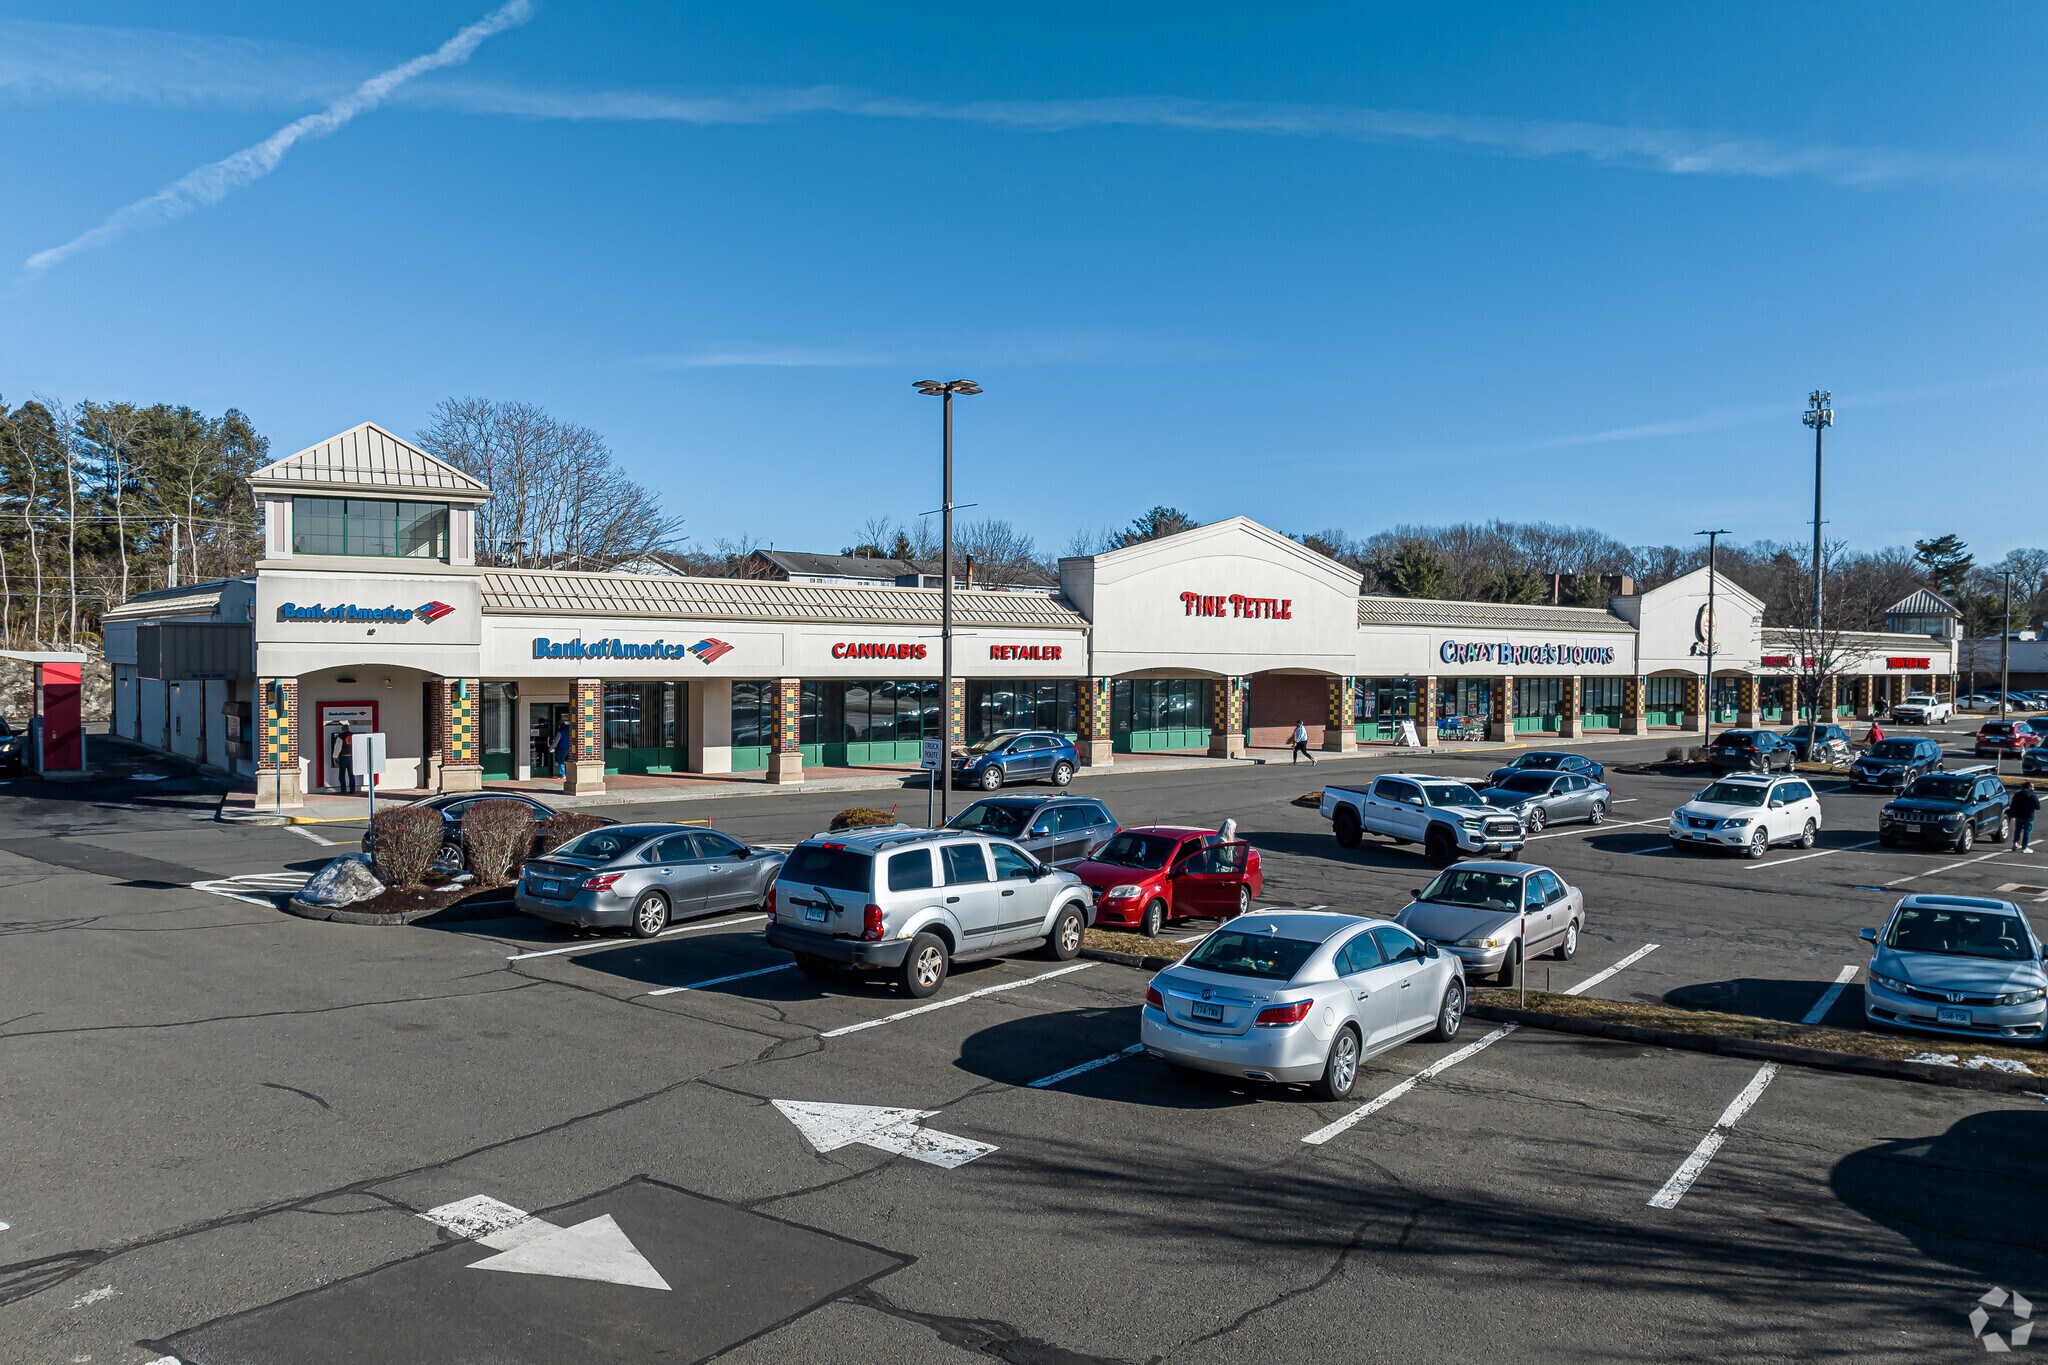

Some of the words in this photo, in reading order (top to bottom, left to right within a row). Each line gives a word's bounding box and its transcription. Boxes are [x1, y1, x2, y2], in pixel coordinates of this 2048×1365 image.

[281, 602, 326, 621] Bank
[328, 603, 346, 621] of
[346, 604, 414, 623] America
[1180, 591, 1227, 618] FINE
[1229, 594, 1292, 620] FETTLE
[534, 637, 587, 658] Bank
[588, 638, 609, 658] of
[609, 638, 685, 659] America
[832, 643, 927, 659] CANNABIS
[990, 645, 1062, 660] RETAILER
[1440, 640, 1496, 665] CRAZY
[1498, 643, 1557, 664] BRUCE'S
[1557, 644, 1615, 665] LIQUORS
[925, 742, 939, 750] TRUCK
[925, 751, 938, 759] ROUTE
